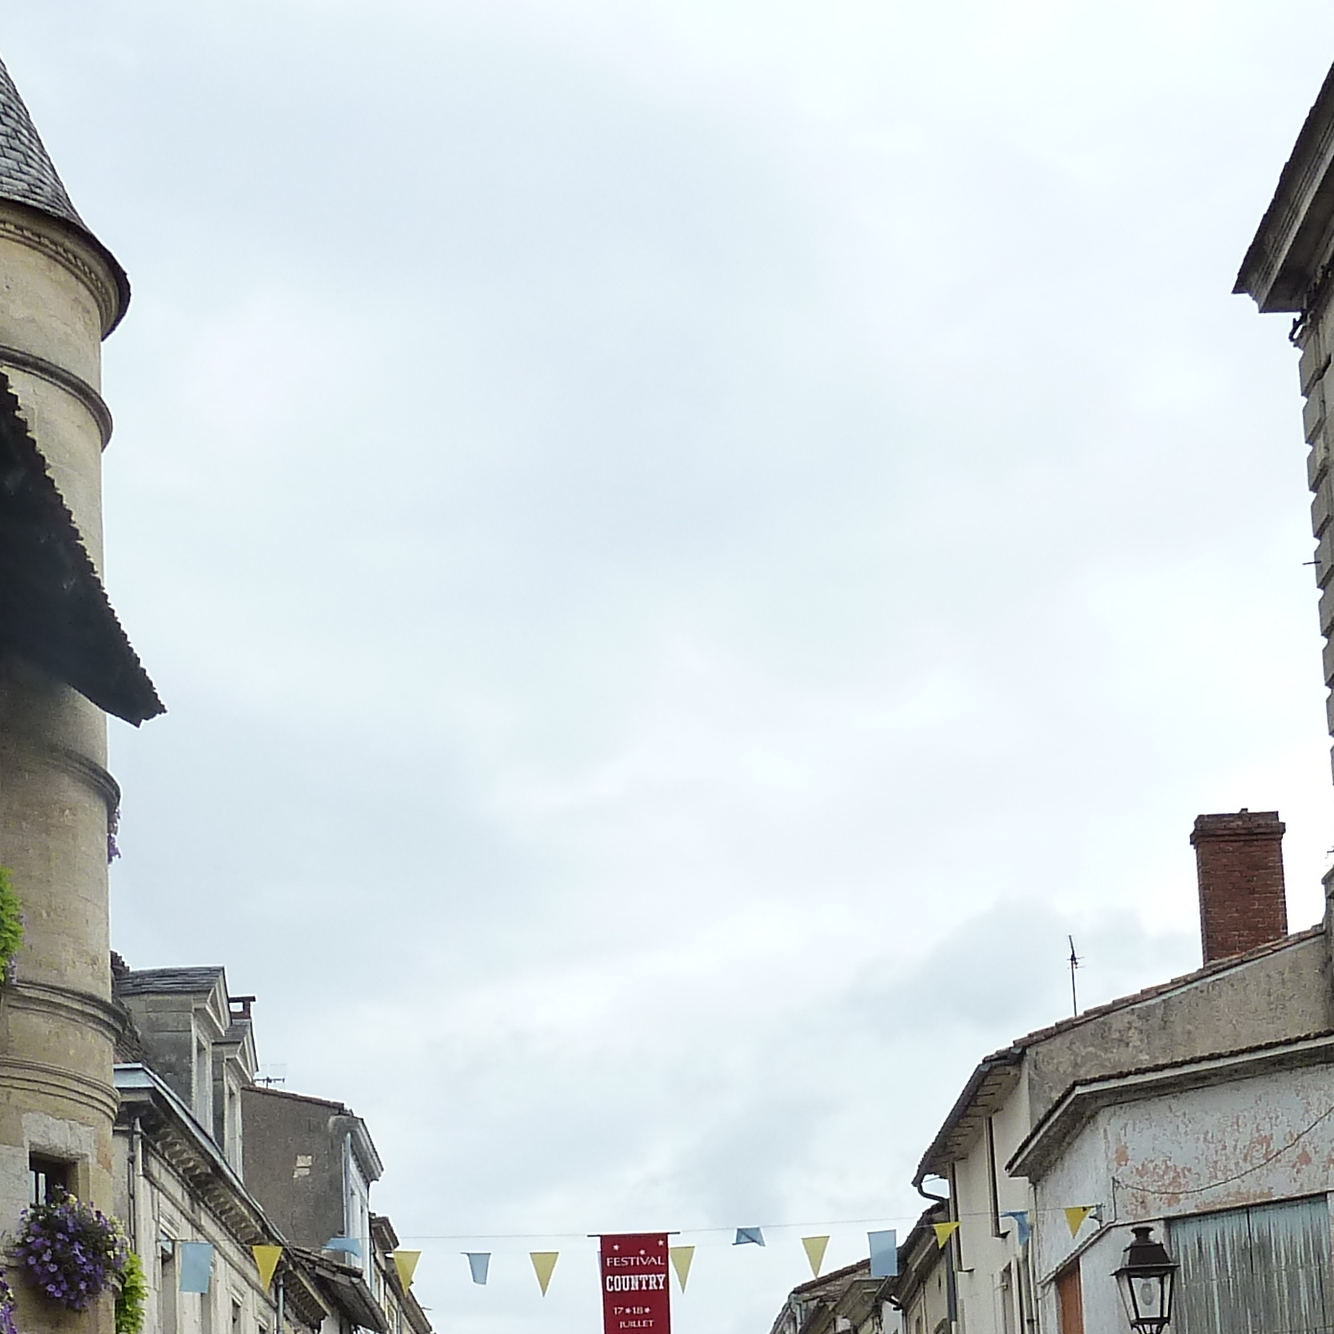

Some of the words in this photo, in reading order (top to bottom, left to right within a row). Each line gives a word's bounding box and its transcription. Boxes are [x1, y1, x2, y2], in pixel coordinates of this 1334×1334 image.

[606, 1256, 665, 1266] FESTIVAL
[606, 1274, 666, 1292] COUNTRY
[613, 1307, 624, 1315] 17
[619, 1319, 654, 1328] JUILLET
